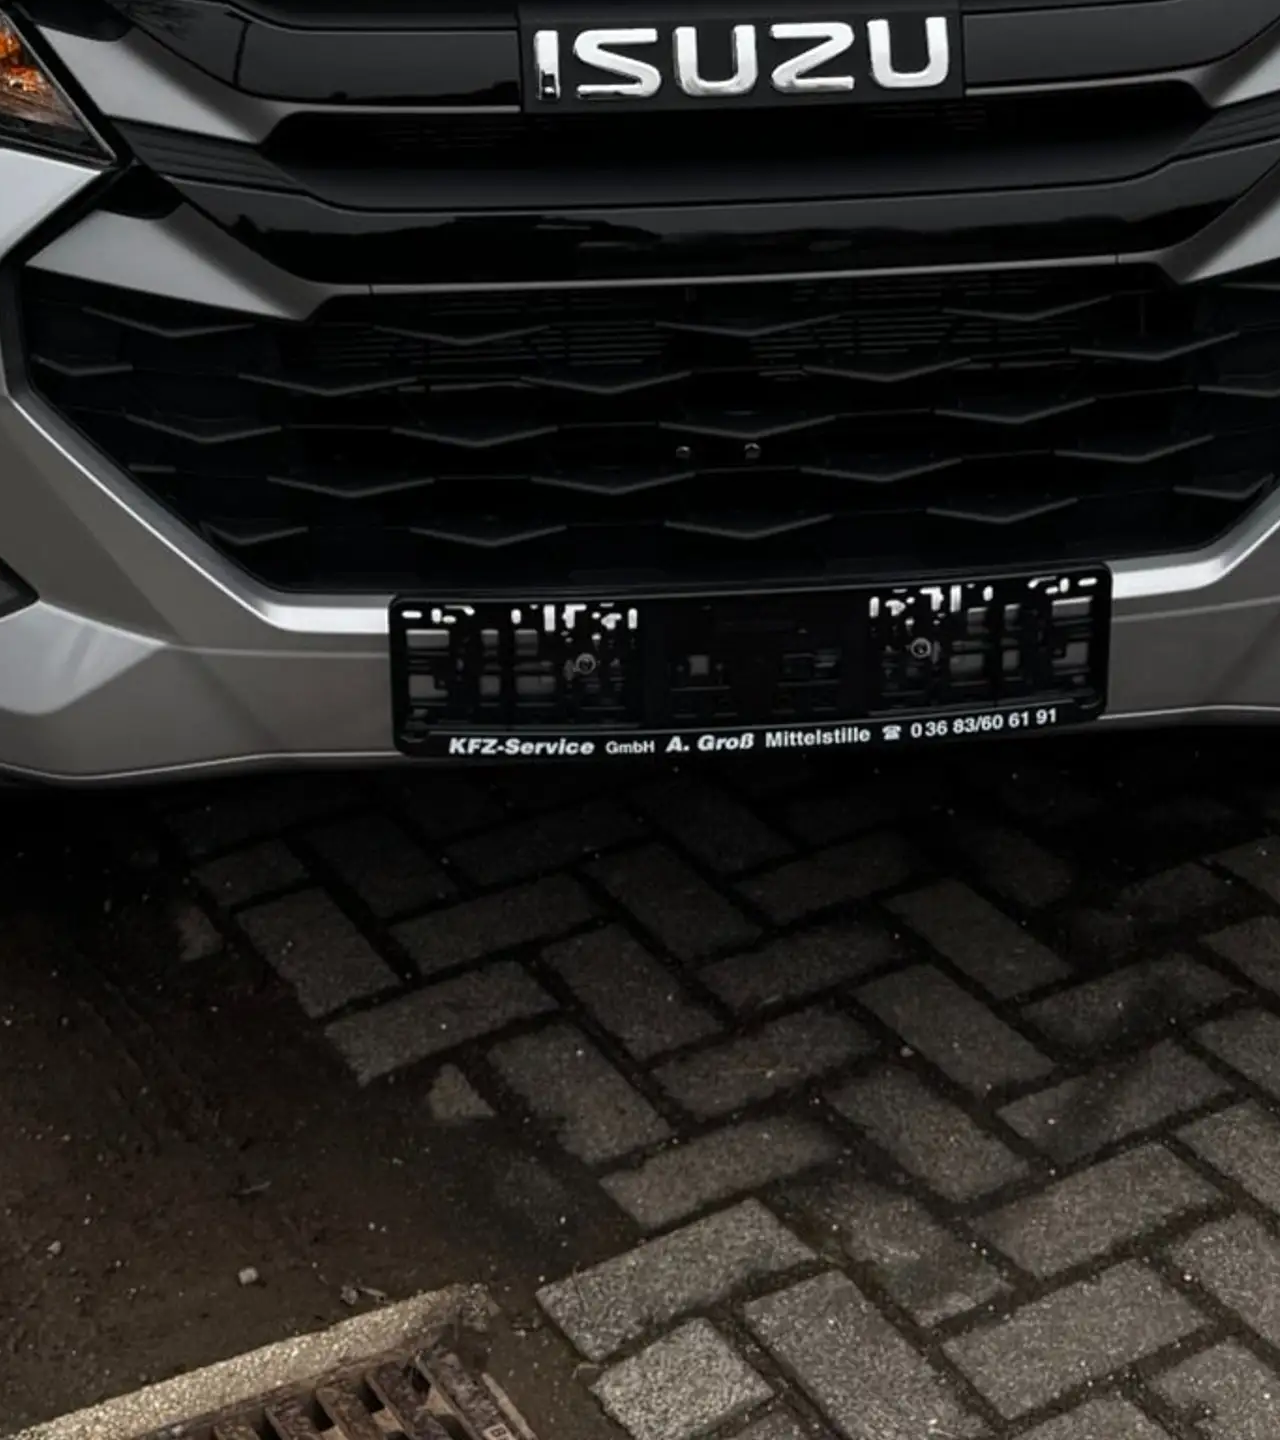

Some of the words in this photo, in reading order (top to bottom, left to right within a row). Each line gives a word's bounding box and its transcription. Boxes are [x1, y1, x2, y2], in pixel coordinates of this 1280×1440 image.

[534, 16, 949, 101] ISUZU
[449, 737, 595, 755] KFZ-Service
[605, 740, 655, 755] GmbH
[666, 735, 690, 753] A.
[697, 732, 755, 751] Groß
[765, 726, 871, 748] Mittelstille
[1009, 711, 1030, 727] 61
[1036, 708, 1057, 724] 91
